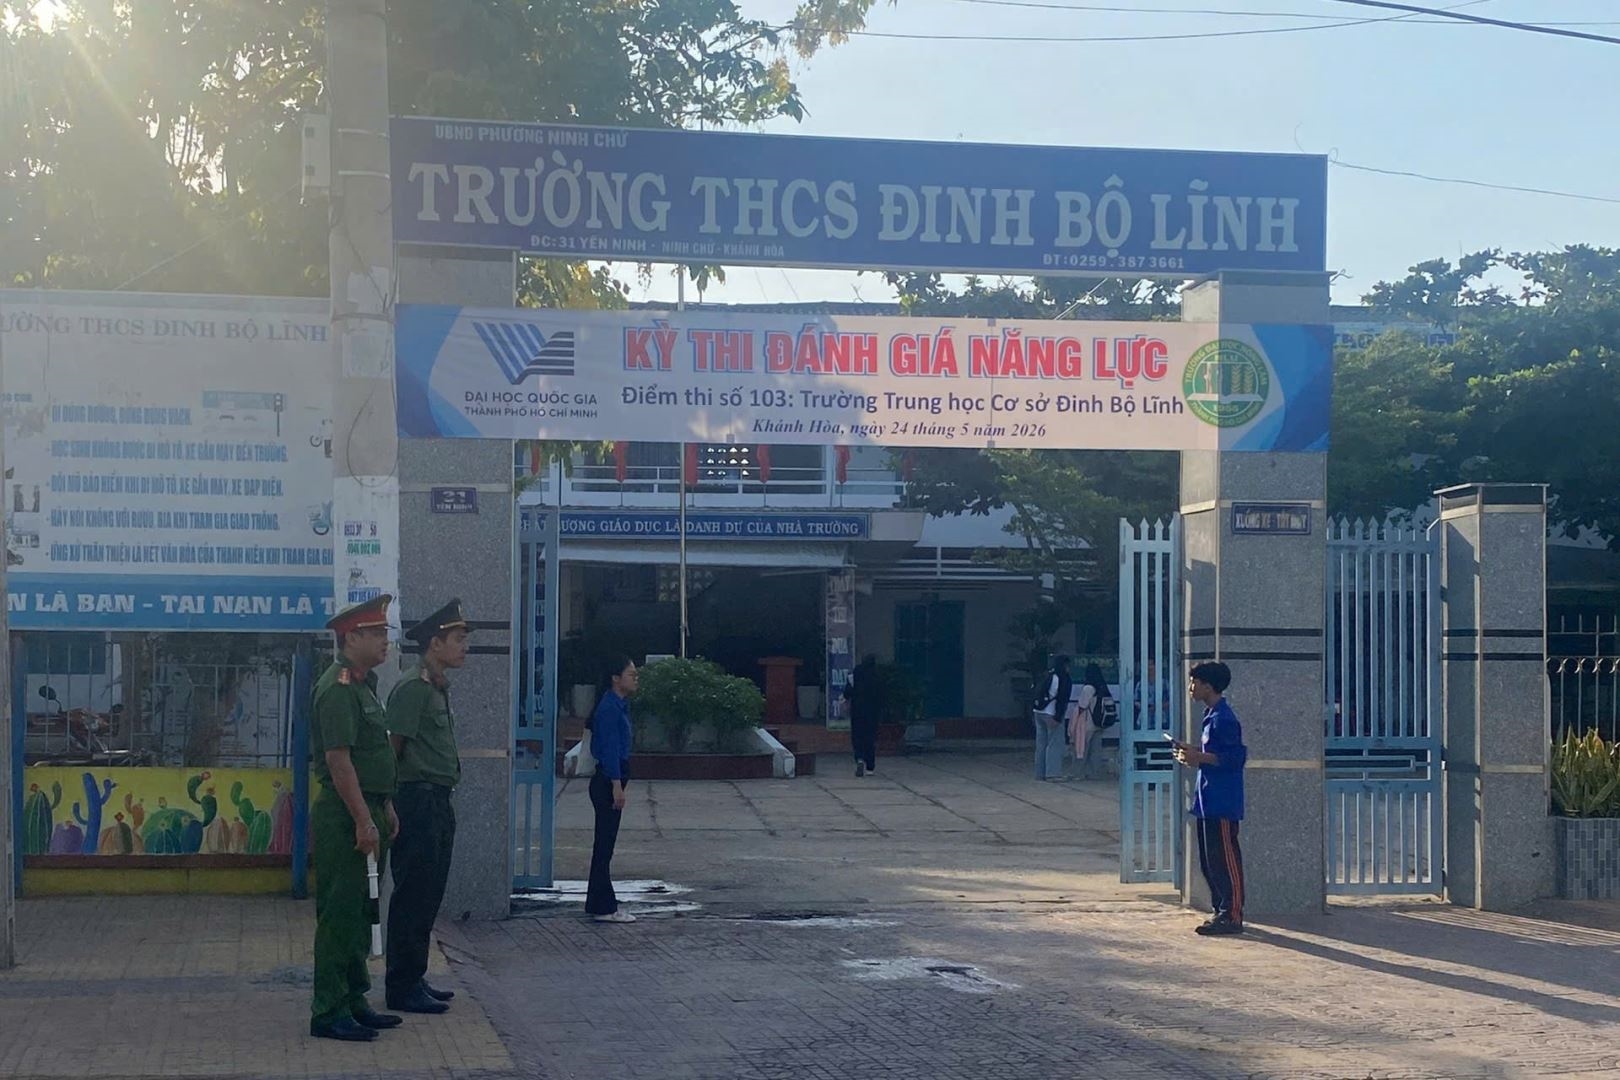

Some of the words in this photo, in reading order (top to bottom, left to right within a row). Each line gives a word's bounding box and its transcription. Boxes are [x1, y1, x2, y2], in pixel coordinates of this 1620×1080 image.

[435, 124, 473, 141] UBND
[548, 130, 588, 147] NINH
[408, 151, 671, 231] TRƯỜNG
[690, 176, 859, 240] THCS
[878, 184, 1035, 246] ĐINH
[1054, 173, 1132, 259] BỘ
[1150, 178, 1300, 254] LĨNH
[530, 234, 575, 249] ĐC:31
[579, 234, 608, 250] YÊN
[612, 238, 646, 251] NINH
[662, 241, 689, 254] NINH
[723, 240, 760, 257] KHÁNH
[79, 315, 145, 336] THCS
[225, 316, 259, 344] BỘ
[268, 319, 327, 342] LĨNH
[623, 319, 679, 372] KỲ
[687, 327, 754, 374] THI
[764, 323, 878, 377] ĐÁNH
[889, 326, 961, 378] GIÁ
[969, 327, 1083, 379] NĂNG
[1093, 334, 1168, 390] LỰC
[464, 391, 488, 405] ĐẠI
[492, 391, 523, 406] HỌC
[527, 389, 573, 405] QUỐC
[574, 394, 598, 405] GIA
[622, 386, 677, 406] Điểm
[685, 387, 712, 407] thi
[720, 385, 742, 407] số
[751, 389, 793, 408] 103:
[800, 388, 878, 413] Trường
[884, 392, 942, 414] Trung
[949, 391, 985, 414] học
[991, 393, 1019, 412] Cơ
[1025, 391, 1049, 412] sở
[1056, 393, 1103, 413] Đinh
[1110, 395, 1136, 417] Bộ
[1143, 396, 1184, 414] Lĩnh
[464, 403, 502, 416] THÀNH
[504, 405, 528, 417] PHỐ
[530, 405, 546, 418] HỒ
[549, 406, 568, 418] CHÍ
[570, 408, 598, 418] MINH
[752, 418, 803, 434] Khánh
[808, 419, 845, 435] Hòa,
[850, 419, 886, 439] ngày
[890, 420, 908, 435] 24
[913, 420, 955, 439] tháng
[960, 421, 969, 436] 5
[973, 423, 1005, 437] năm
[1011, 422, 1047, 437] 2026
[599, 517, 631, 533] GIÁO
[635, 520, 661, 534] DỤC
[665, 519, 682, 533] LÀ
[686, 521, 721, 533] DANH
[725, 520, 744, 536] DỰ
[747, 518, 772, 534] CỦA
[776, 519, 803, 534] NHÀ
[807, 519, 859, 535] TRƯỜNG
[35, 590, 69, 613] LÀ
[77, 594, 135, 616] BẠN
[161, 595, 206, 614] TAI
[213, 596, 272, 617] NẠN
[280, 593, 314, 615] LÀ
